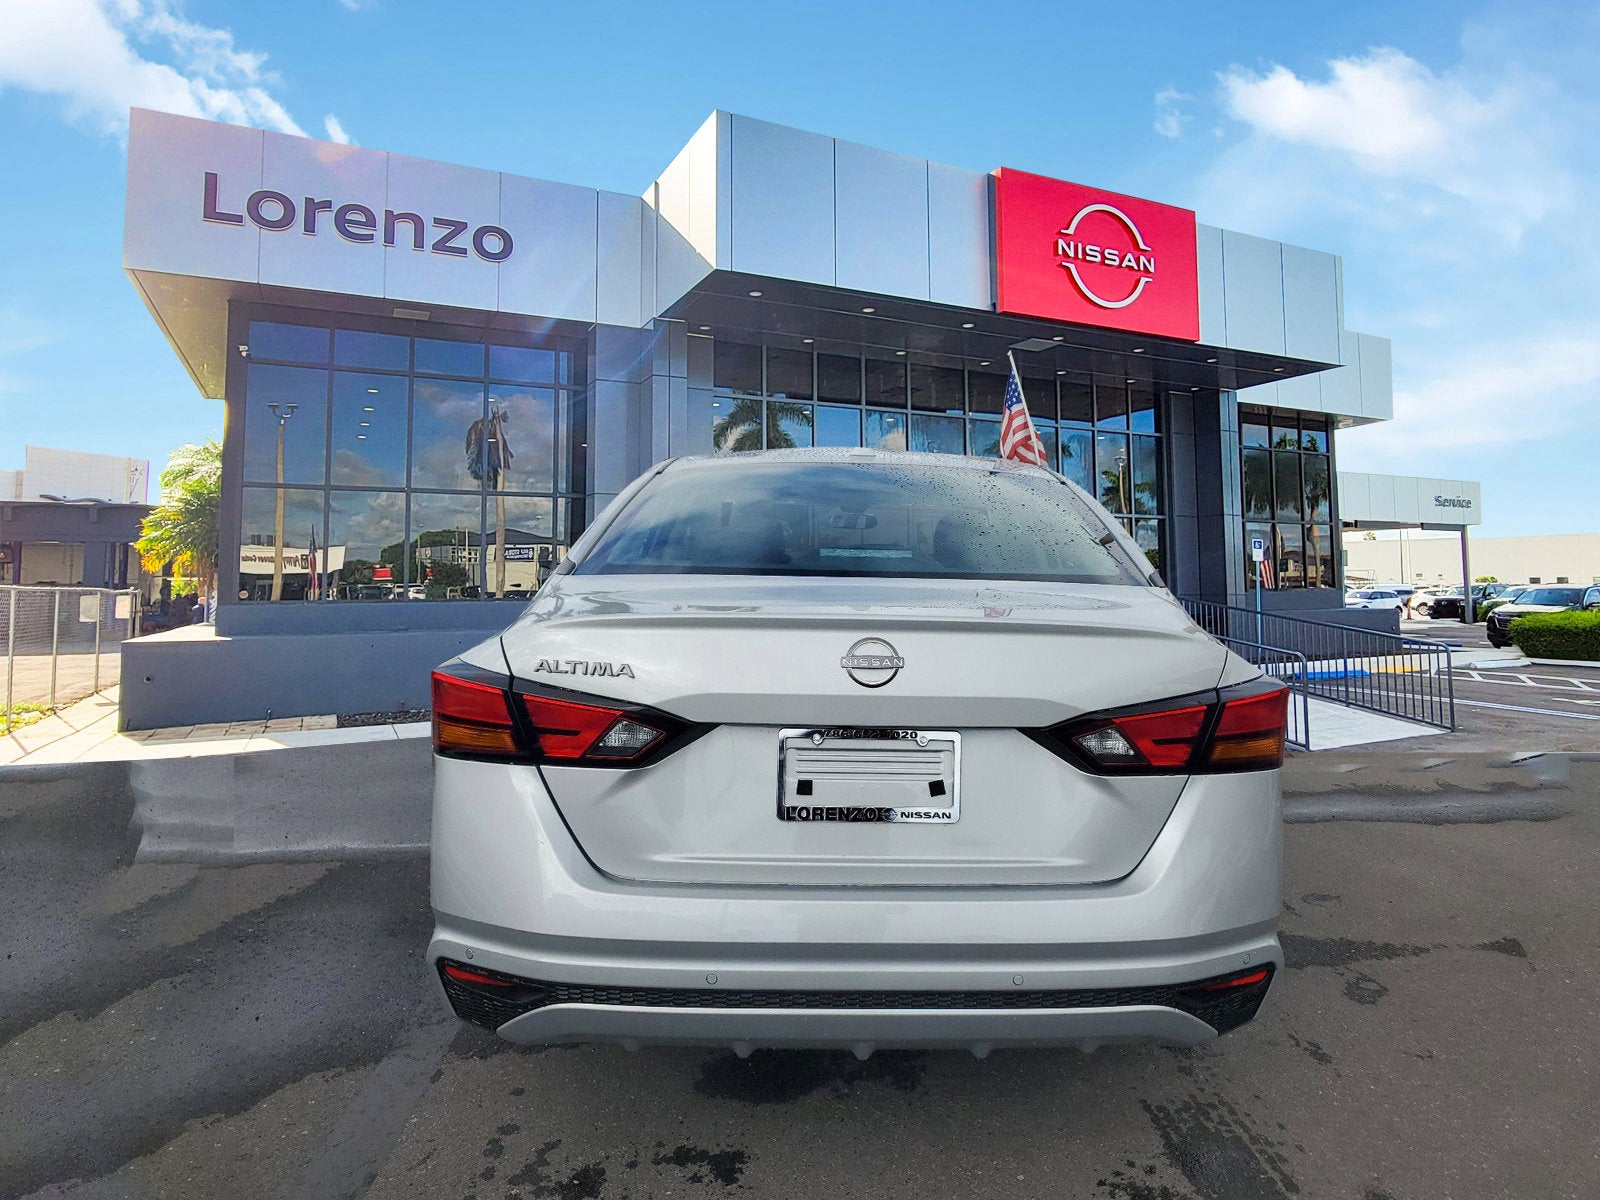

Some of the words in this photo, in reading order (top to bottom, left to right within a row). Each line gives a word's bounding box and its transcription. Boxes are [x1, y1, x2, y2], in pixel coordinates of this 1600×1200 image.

[202, 171, 515, 262] Lorenzo
[1057, 238, 1155, 273] NISSAN
[1434, 495, 1472, 509] Service
[533, 659, 636, 679] ALTIMA
[841, 658, 903, 667] NISSAN
[784, 806, 879, 821] LORENZO
[900, 811, 951, 820] NISSAN
